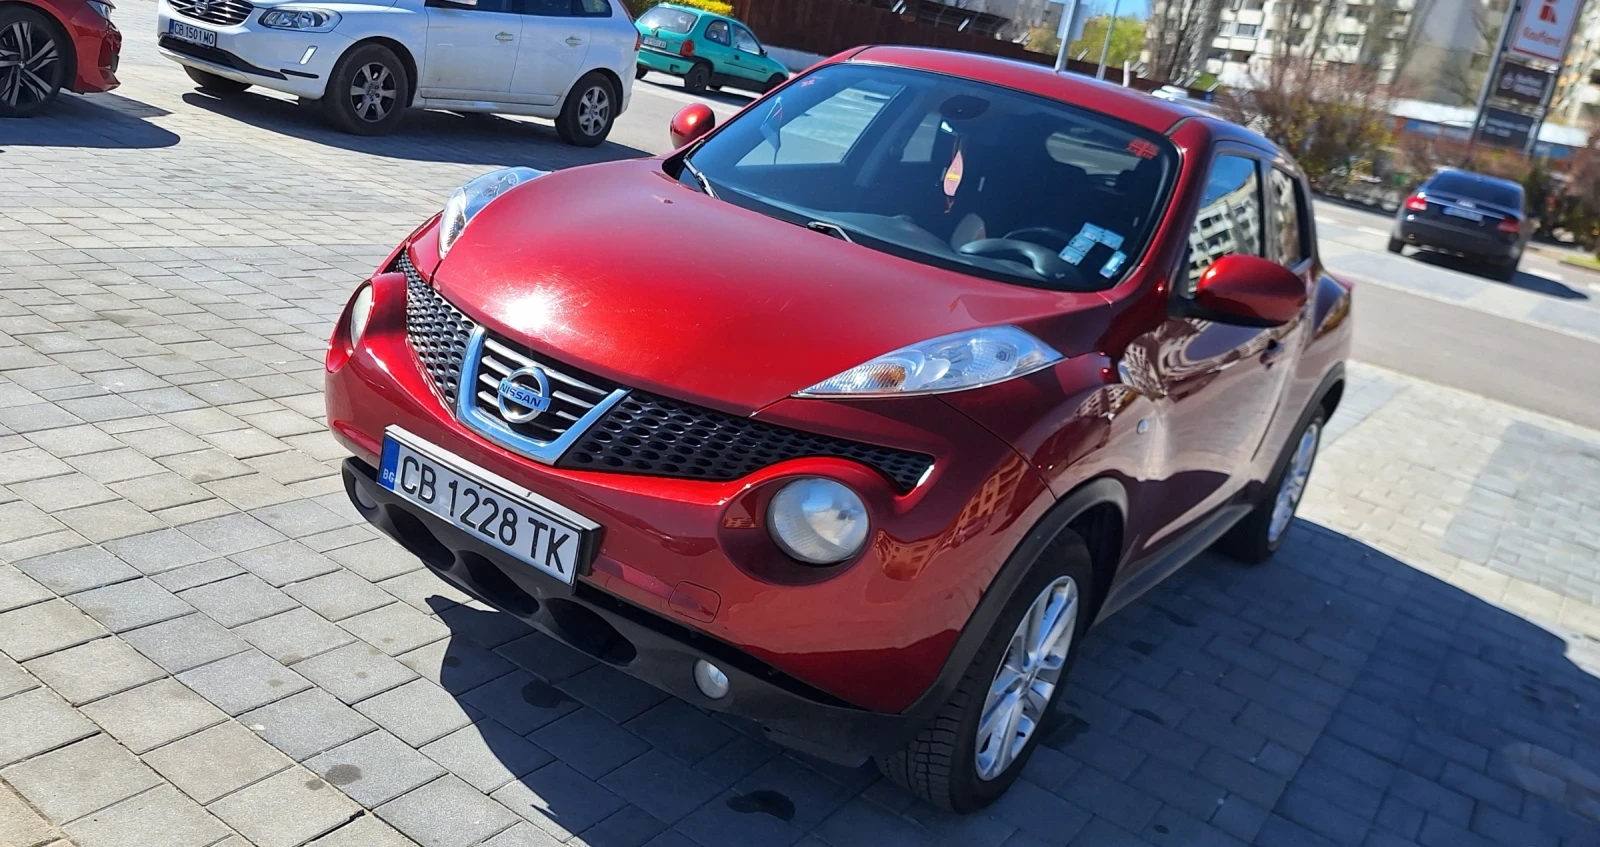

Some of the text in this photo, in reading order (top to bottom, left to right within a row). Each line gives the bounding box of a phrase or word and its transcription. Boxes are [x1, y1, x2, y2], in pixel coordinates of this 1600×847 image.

[174, 23, 184, 36] CB
[186, 26, 202, 41] 1501
[500, 383, 542, 408] NISSAN
[382, 468, 395, 483] BG
[401, 455, 570, 574] CB 1228 TK
